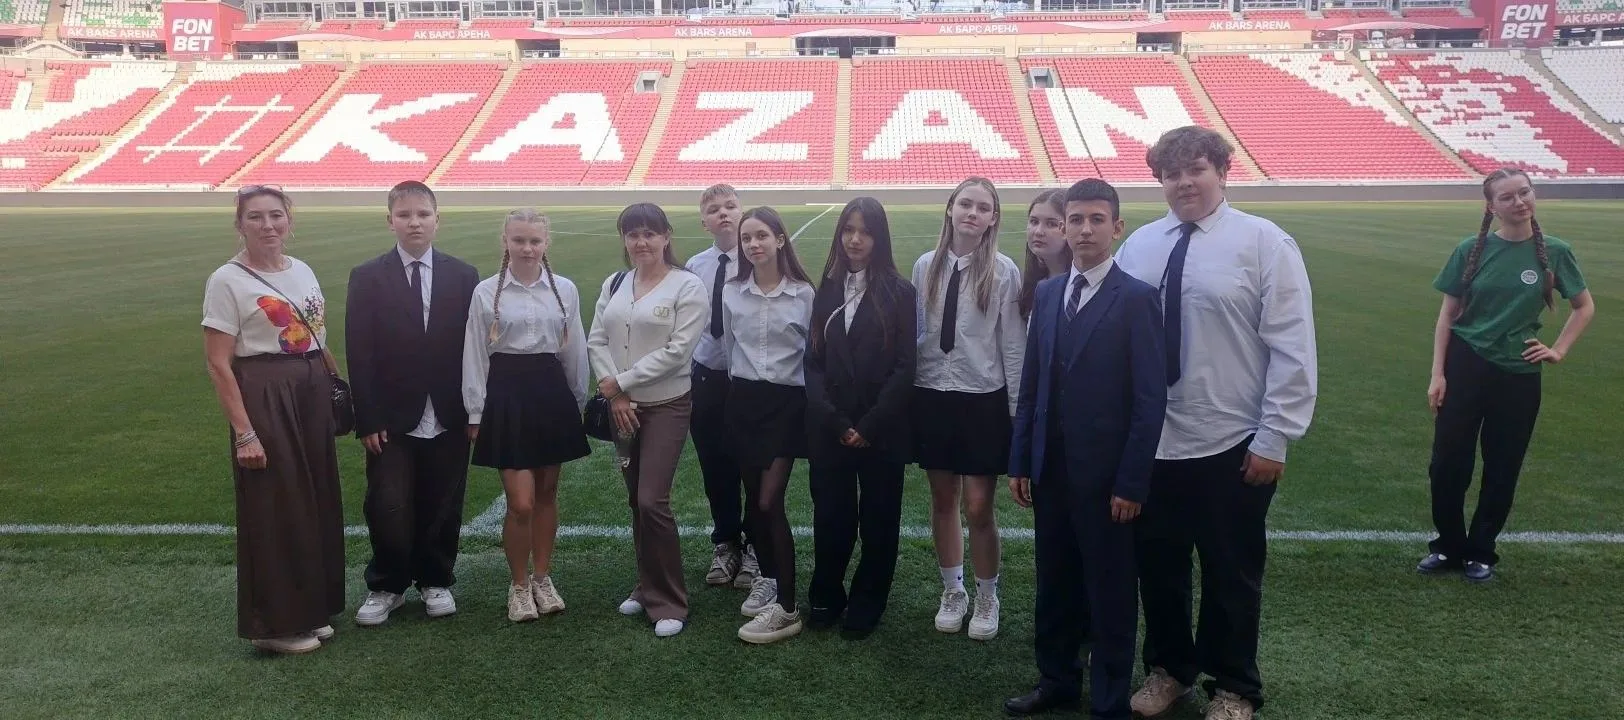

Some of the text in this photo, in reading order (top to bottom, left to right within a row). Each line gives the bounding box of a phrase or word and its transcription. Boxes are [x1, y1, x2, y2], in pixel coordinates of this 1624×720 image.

[1502, 4, 1549, 21] FON
[1582, 12, 1616, 24] БАРС
[172, 18, 213, 35] FON
[955, 24, 982, 34] БАРС
[984, 24, 1019, 34] АРЕНА
[1208, 20, 1291, 30] AK BARS ARENA
[1501, 22, 1547, 39] BET
[67, 29, 158, 38] AK BARS ARENA
[429, 30, 456, 39] БАРС
[457, 30, 491, 39] АРЕНА
[674, 27, 752, 37] AK BARS ARENA
[173, 36, 214, 52] BET
